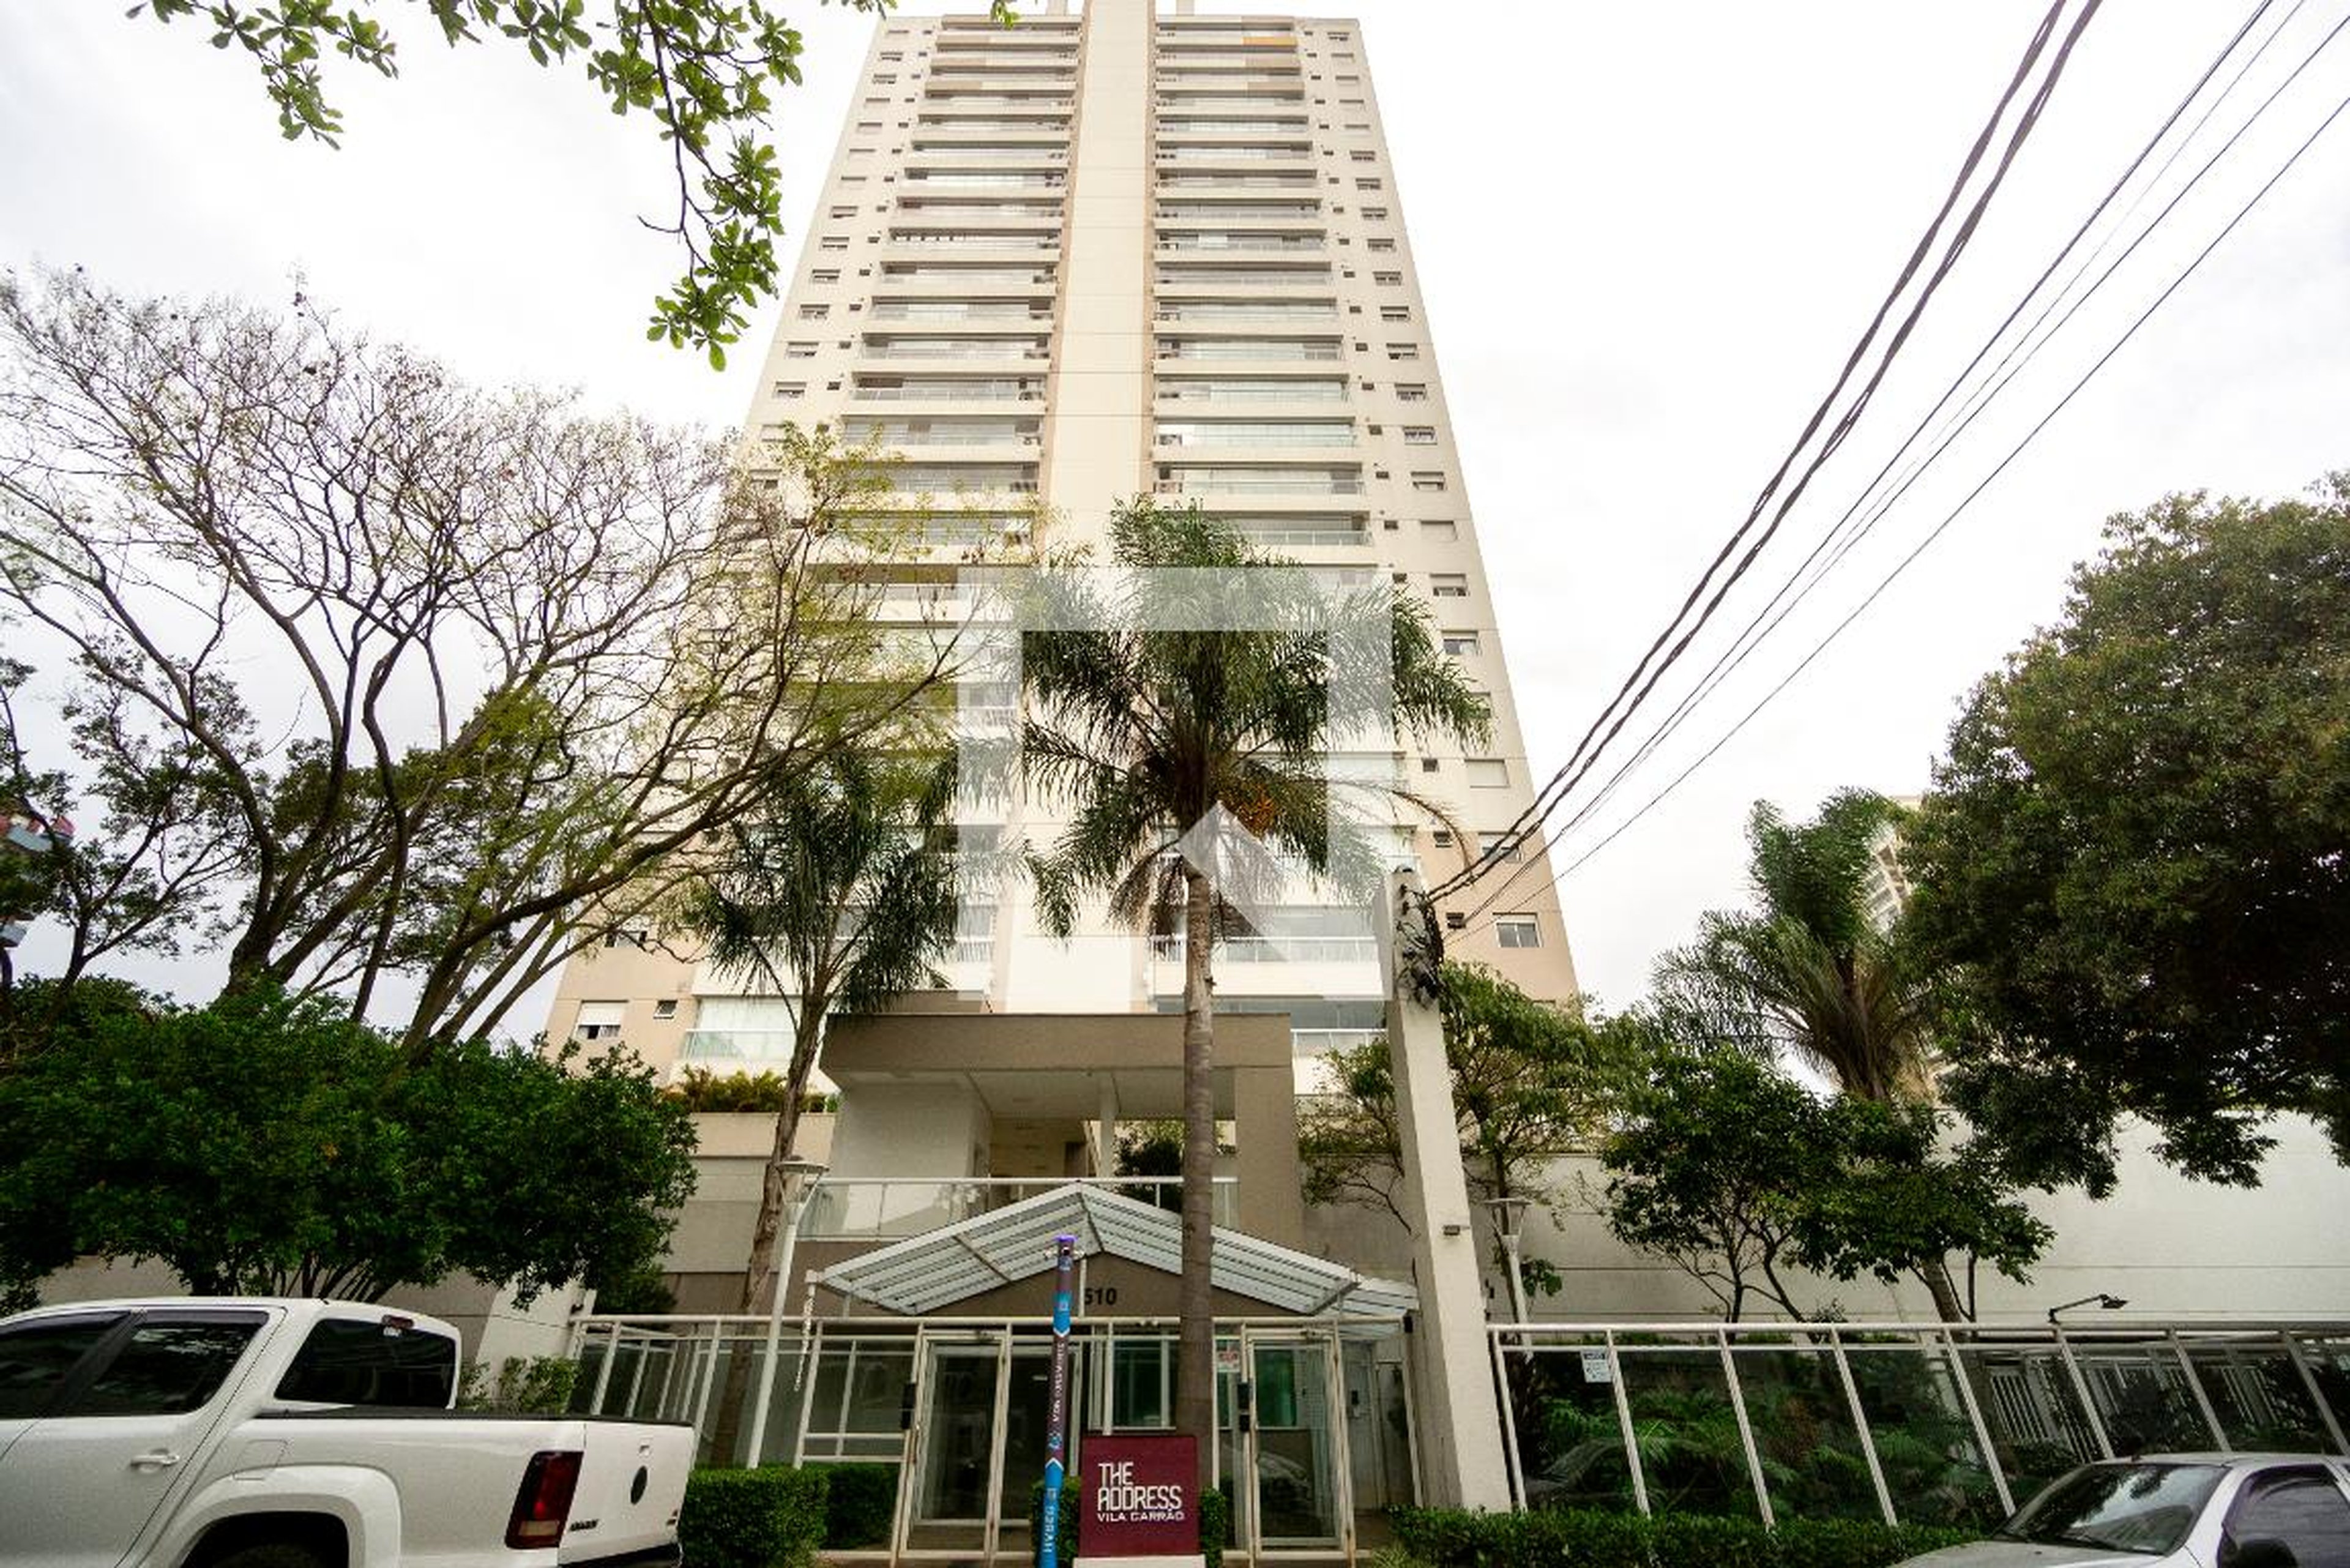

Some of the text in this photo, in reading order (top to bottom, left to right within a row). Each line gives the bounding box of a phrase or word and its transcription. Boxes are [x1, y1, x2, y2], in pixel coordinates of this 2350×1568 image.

[1098, 1462, 1133, 1485] THE
[1098, 1485, 1182, 1511] ADDRESS
[1097, 1512, 1126, 1522] VILA
